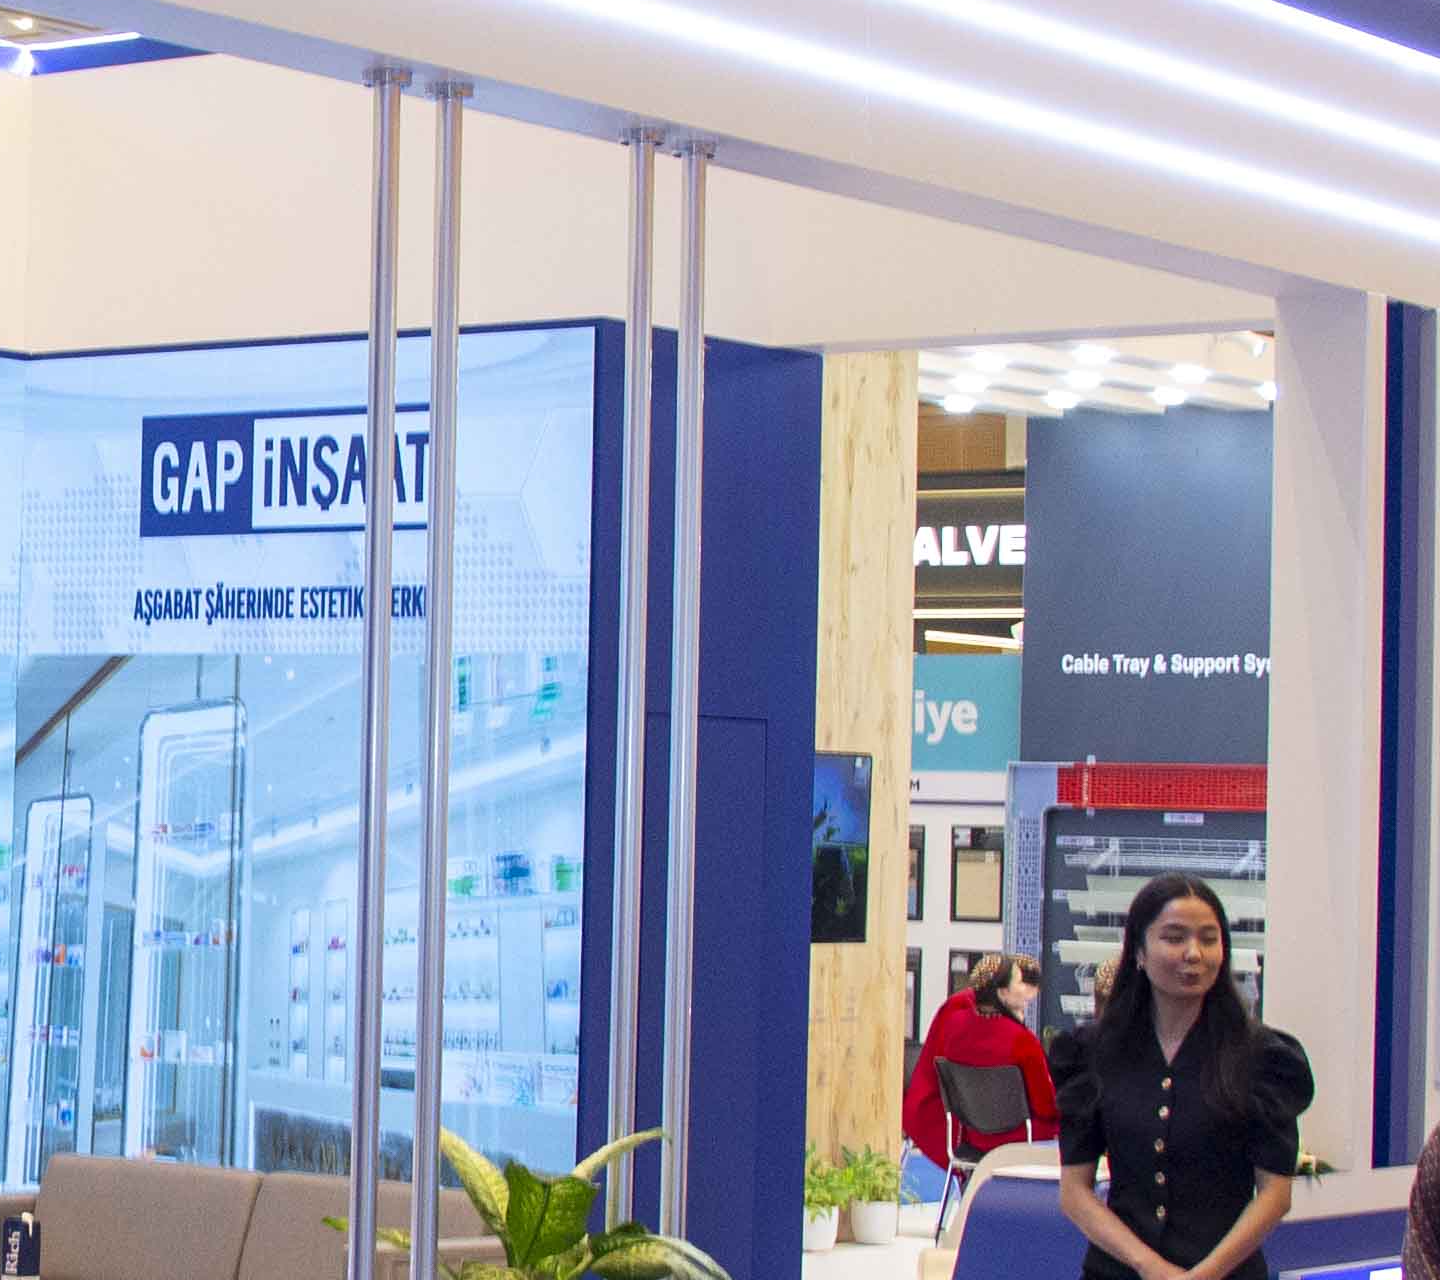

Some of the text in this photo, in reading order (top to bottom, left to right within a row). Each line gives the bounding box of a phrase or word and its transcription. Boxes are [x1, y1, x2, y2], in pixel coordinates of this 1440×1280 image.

[152, 439, 243, 514] GAP
[134, 587, 201, 626] AŞGABAT
[300, 584, 364, 619] ESTETIK
[1062, 654, 1108, 674] Cable
[1113, 654, 1149, 678] Tray
[1154, 655, 1166, 674] &
[1171, 654, 1239, 678] Support
